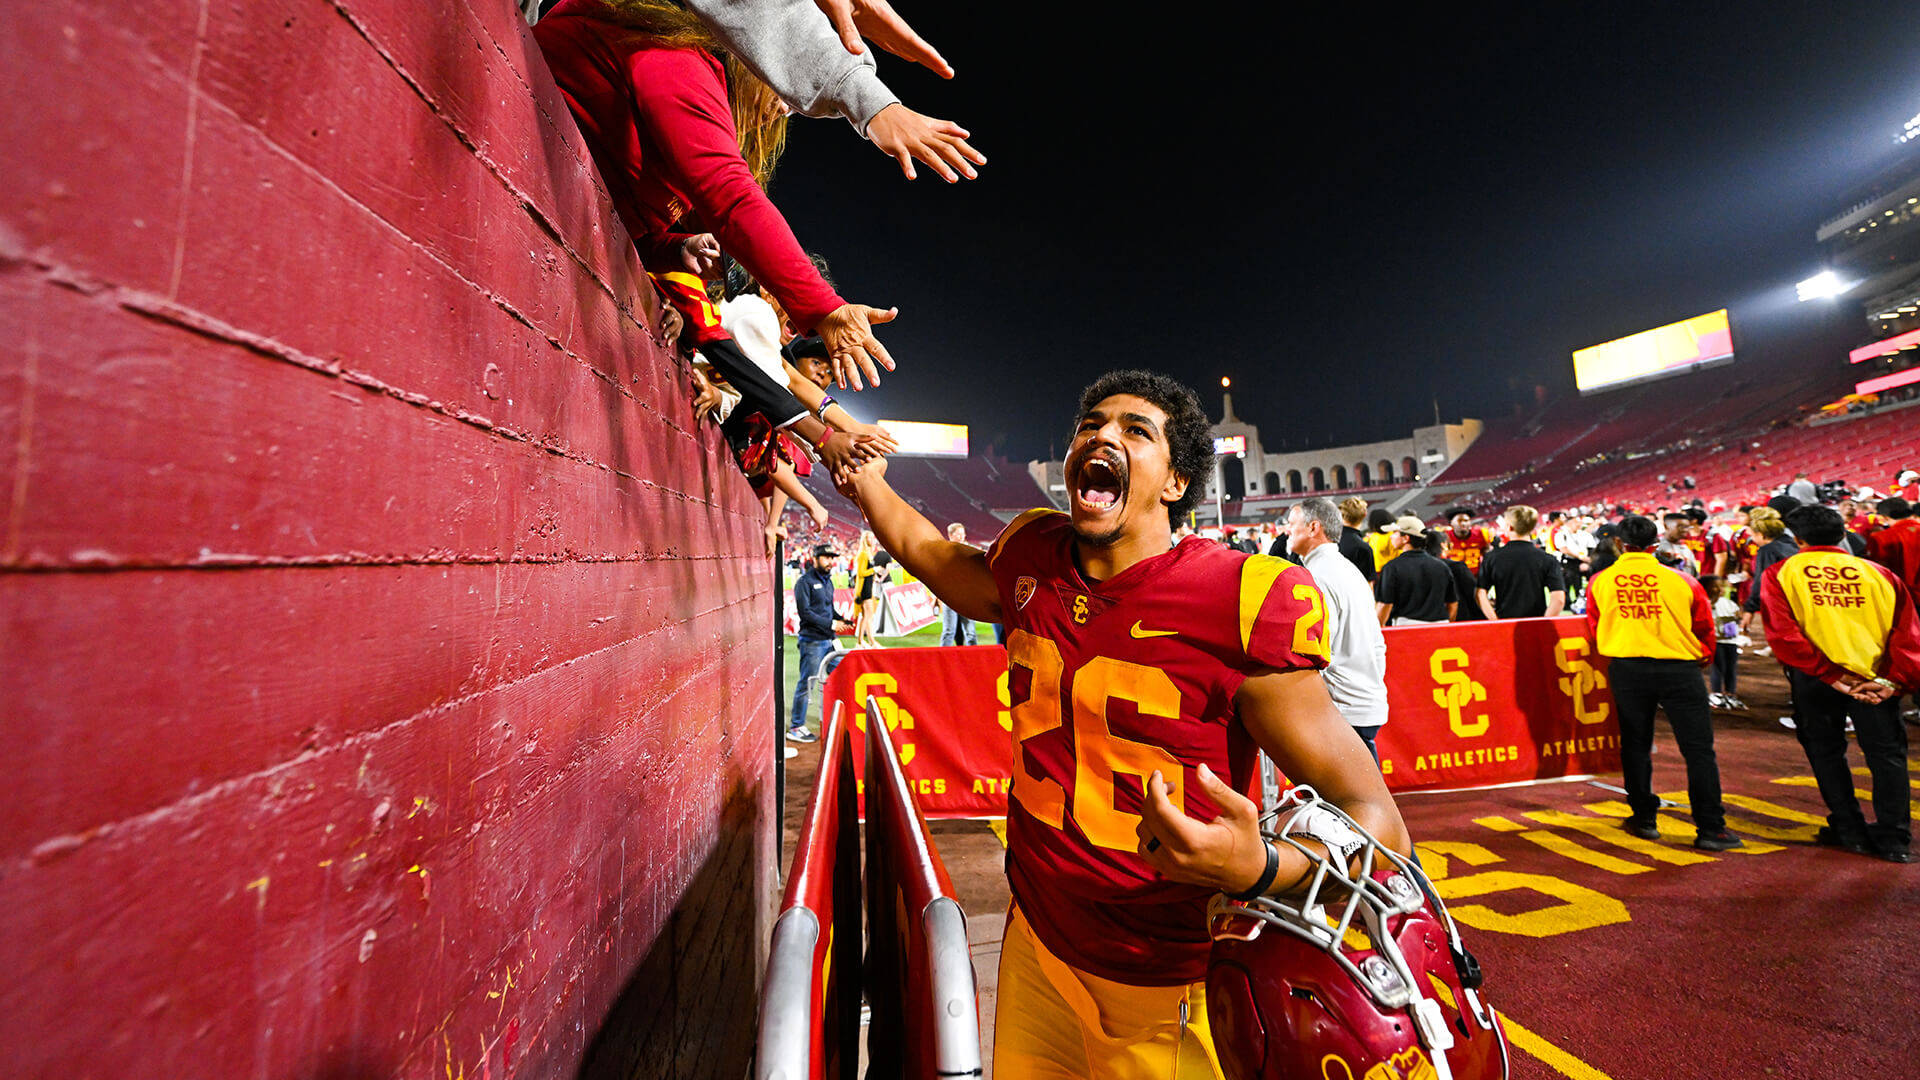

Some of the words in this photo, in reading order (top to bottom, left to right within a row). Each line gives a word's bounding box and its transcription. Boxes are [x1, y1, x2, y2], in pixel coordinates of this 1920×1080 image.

[1614, 574, 1658, 588] CSC
[1803, 565, 1860, 581] CSC
[1616, 589, 1659, 603] EVENT
[1808, 581, 1861, 594] EVENT
[1073, 595, 1089, 624] SC
[1619, 605, 1662, 619] STAFF
[1813, 594, 1866, 608] STAFF
[1291, 584, 1331, 664] 2
[1554, 636, 1610, 725] SC
[1429, 647, 1490, 738] SC
[1006, 628, 1185, 853] 26
[1542, 735, 1622, 757] ATHLETI
[1415, 746, 1519, 771] ATHLETICS
